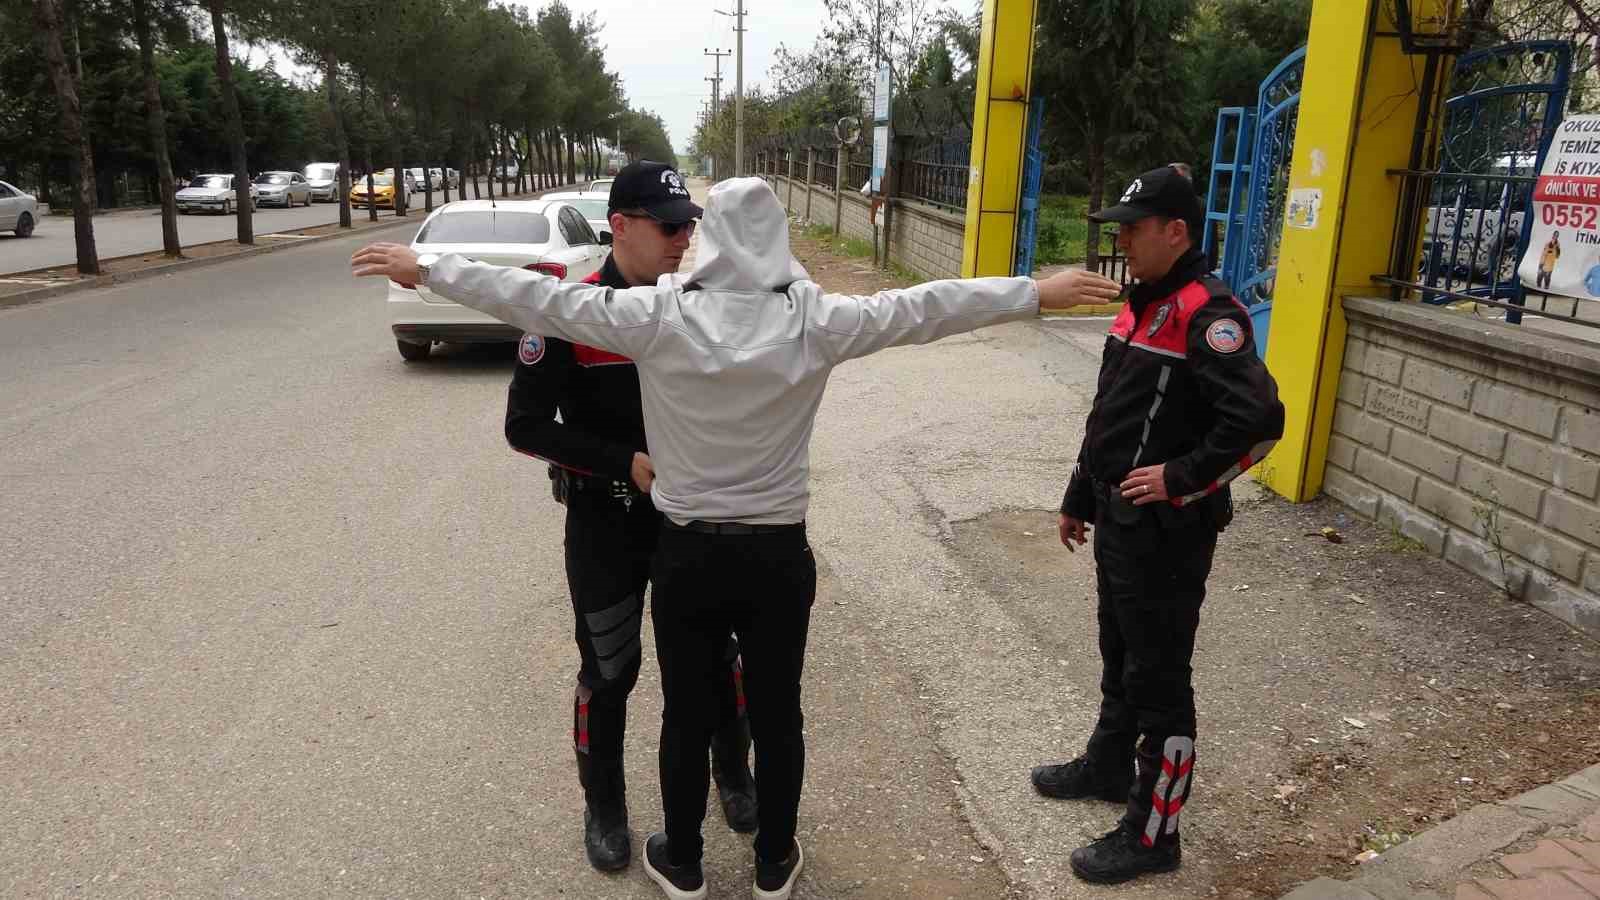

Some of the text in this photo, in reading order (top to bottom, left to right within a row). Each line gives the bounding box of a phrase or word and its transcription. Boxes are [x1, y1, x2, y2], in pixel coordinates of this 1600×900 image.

[1560, 137, 1600, 154] TEMİZ
[1544, 179, 1598, 198] ÖNLÜK VE
[1543, 204, 1597, 230] 0552
